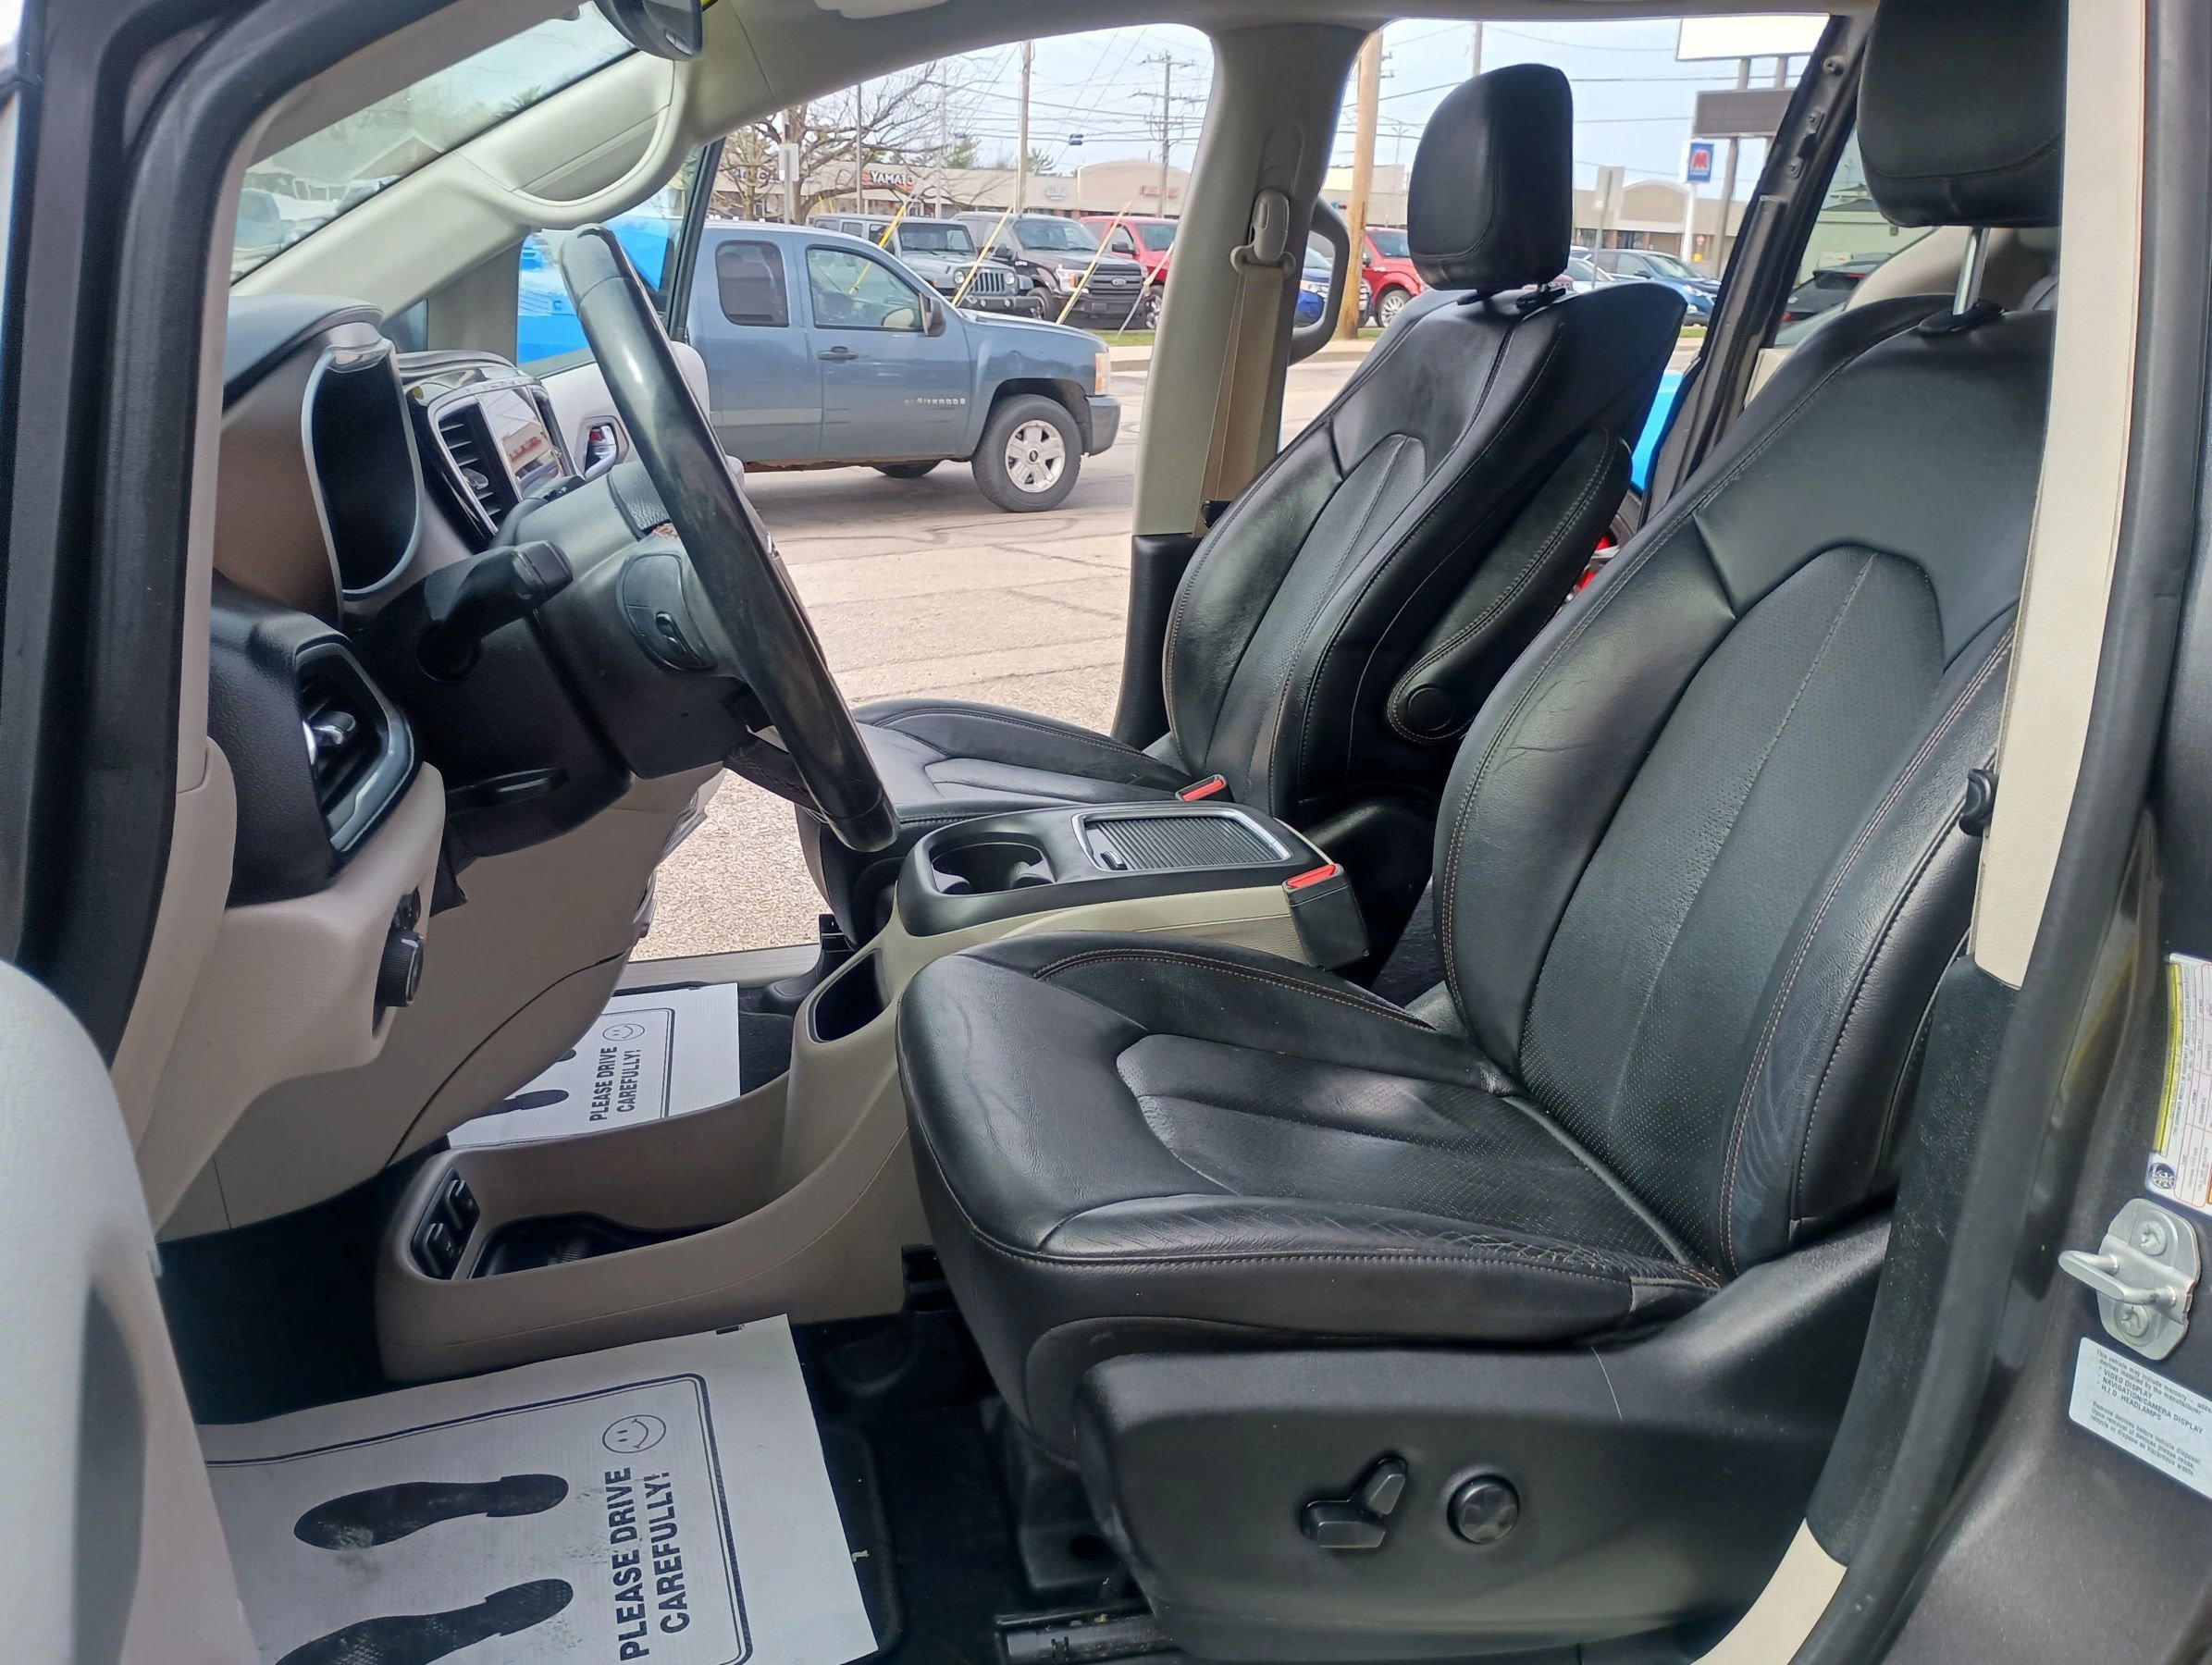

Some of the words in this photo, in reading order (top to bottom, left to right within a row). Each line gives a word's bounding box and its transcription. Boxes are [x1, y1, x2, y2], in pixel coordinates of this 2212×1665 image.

[597, 1047, 617, 1078] DRIVE
[616, 1049, 641, 1113] CAREFULLY!
[589, 1080, 612, 1121] PLEASE
[2104, 1369, 2123, 1384] VIDEO
[2124, 1380, 2153, 1399] DISPLAY
[2129, 1367, 2141, 1377] may
[2145, 1381, 2153, 1390] by
[2153, 1386, 2163, 1395] the
[2103, 1376, 2171, 1418] NAVIGATION/CAMERA
[2173, 1413, 2204, 1434] DISPLAY
[2120, 1394, 2161, 1421] HEADLAMPS
[604, 1467, 637, 1545] DRIVE
[644, 1472, 690, 1634] CAREFULLY!
[612, 1549, 649, 1661] PLEASE
